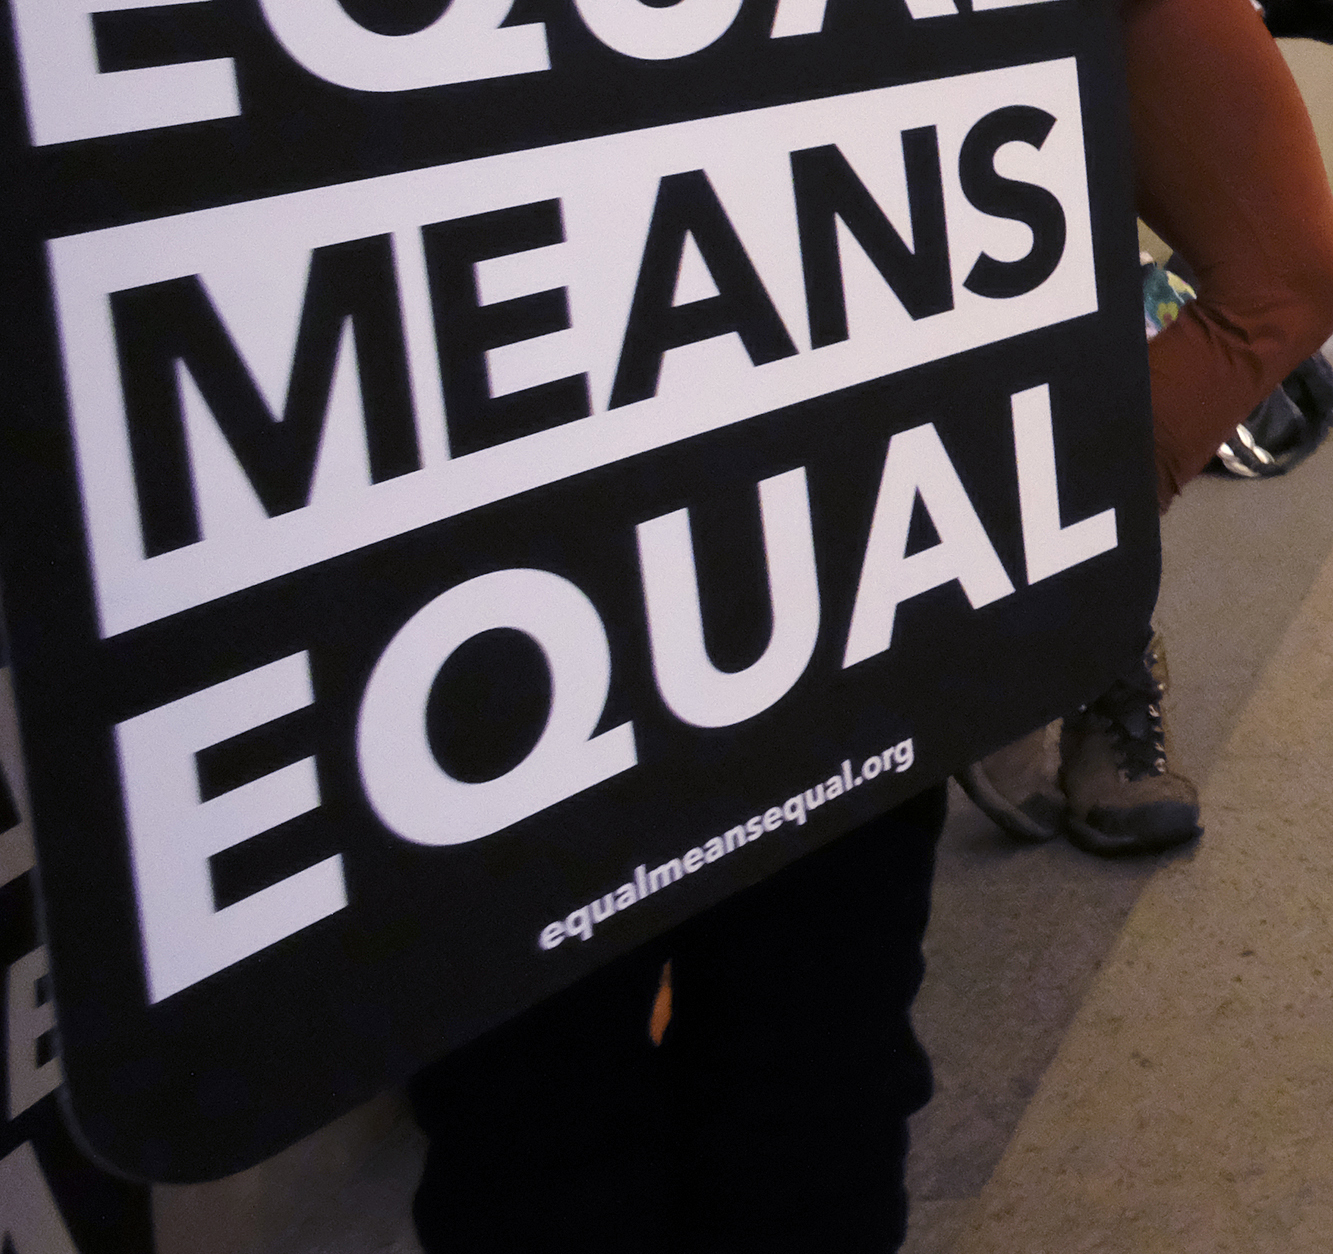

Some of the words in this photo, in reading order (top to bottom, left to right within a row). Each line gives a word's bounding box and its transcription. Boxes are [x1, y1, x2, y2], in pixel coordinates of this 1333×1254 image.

[108, 103, 1067, 560] MEANS
[113, 383, 1118, 1006] EQUAL
[538, 737, 914, 951] equalmeansequal.org
